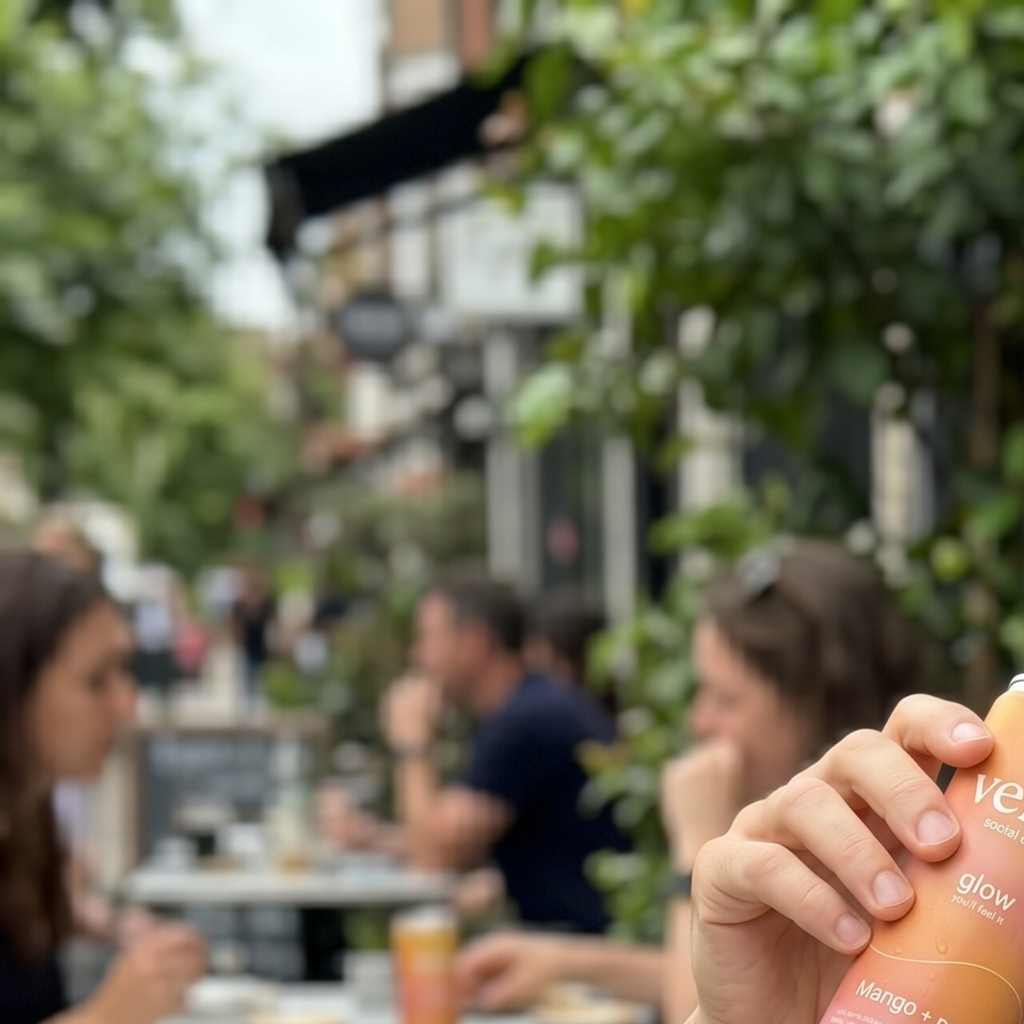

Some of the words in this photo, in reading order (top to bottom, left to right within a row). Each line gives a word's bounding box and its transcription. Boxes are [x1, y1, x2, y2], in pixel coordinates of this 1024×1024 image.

[983, 817, 1021, 841] social
[956, 873, 1017, 911] glow
[855, 979, 917, 1016] Mango
[921, 1010, 932, 1022] +
